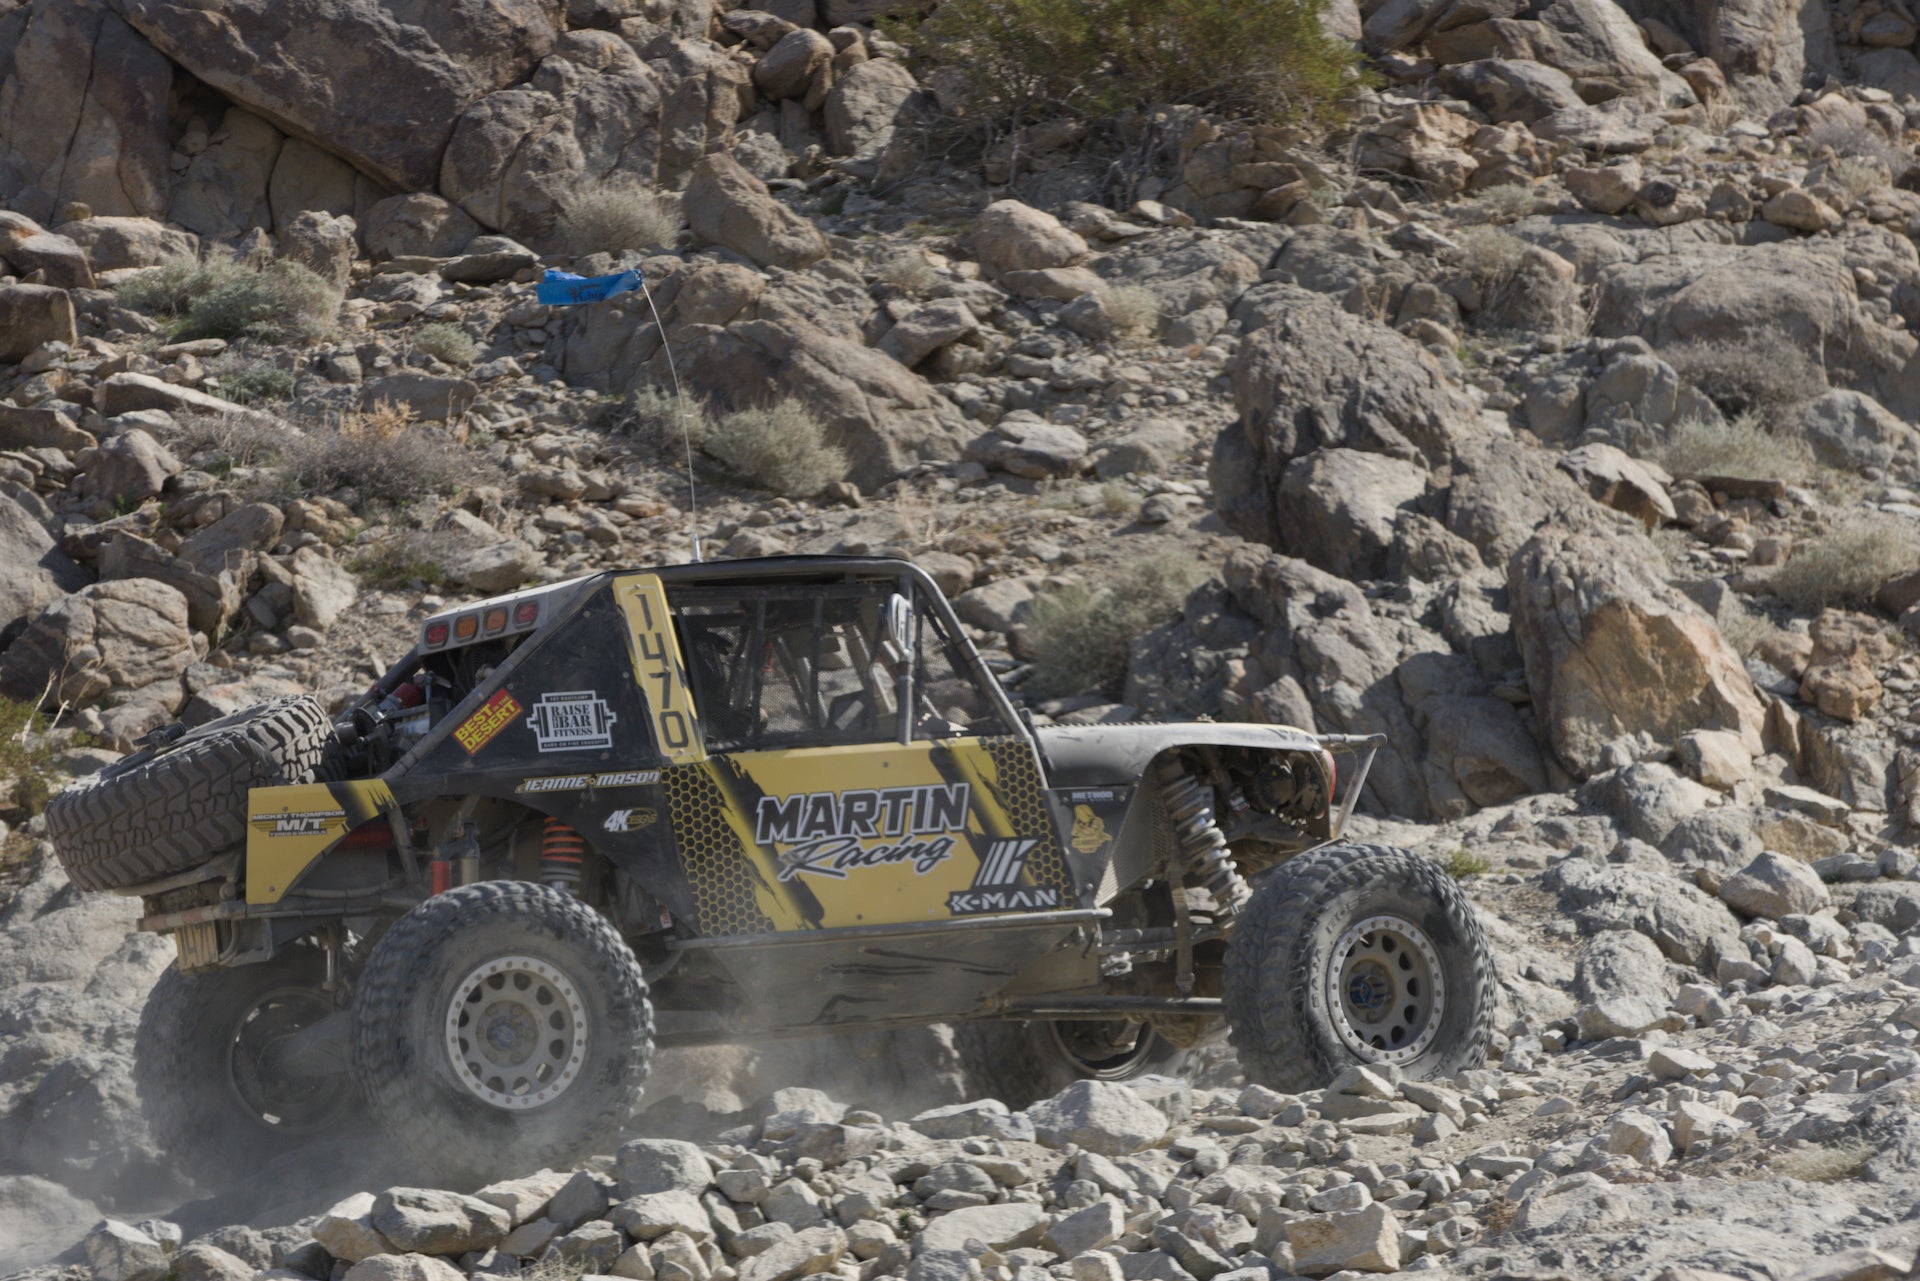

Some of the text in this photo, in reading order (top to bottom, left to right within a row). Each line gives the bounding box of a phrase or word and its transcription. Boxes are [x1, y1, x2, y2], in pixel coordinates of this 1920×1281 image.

[635, 593, 689, 748] 1470
[551, 704, 591, 716] RAISE
[559, 715, 592, 728] BAR
[454, 703, 493, 741] BEST
[463, 699, 516, 751] DESERT
[553, 727, 593, 738] FITNESS
[595, 771, 660, 786] MASON
[252, 809, 346, 821] MICKEY THOMPSON
[276, 817, 326, 832] M/T
[603, 809, 633, 832] 4K
[755, 782, 971, 845] MARTIN
[777, 833, 956, 881] Racing
[950, 889, 1057, 912] K-MAN
